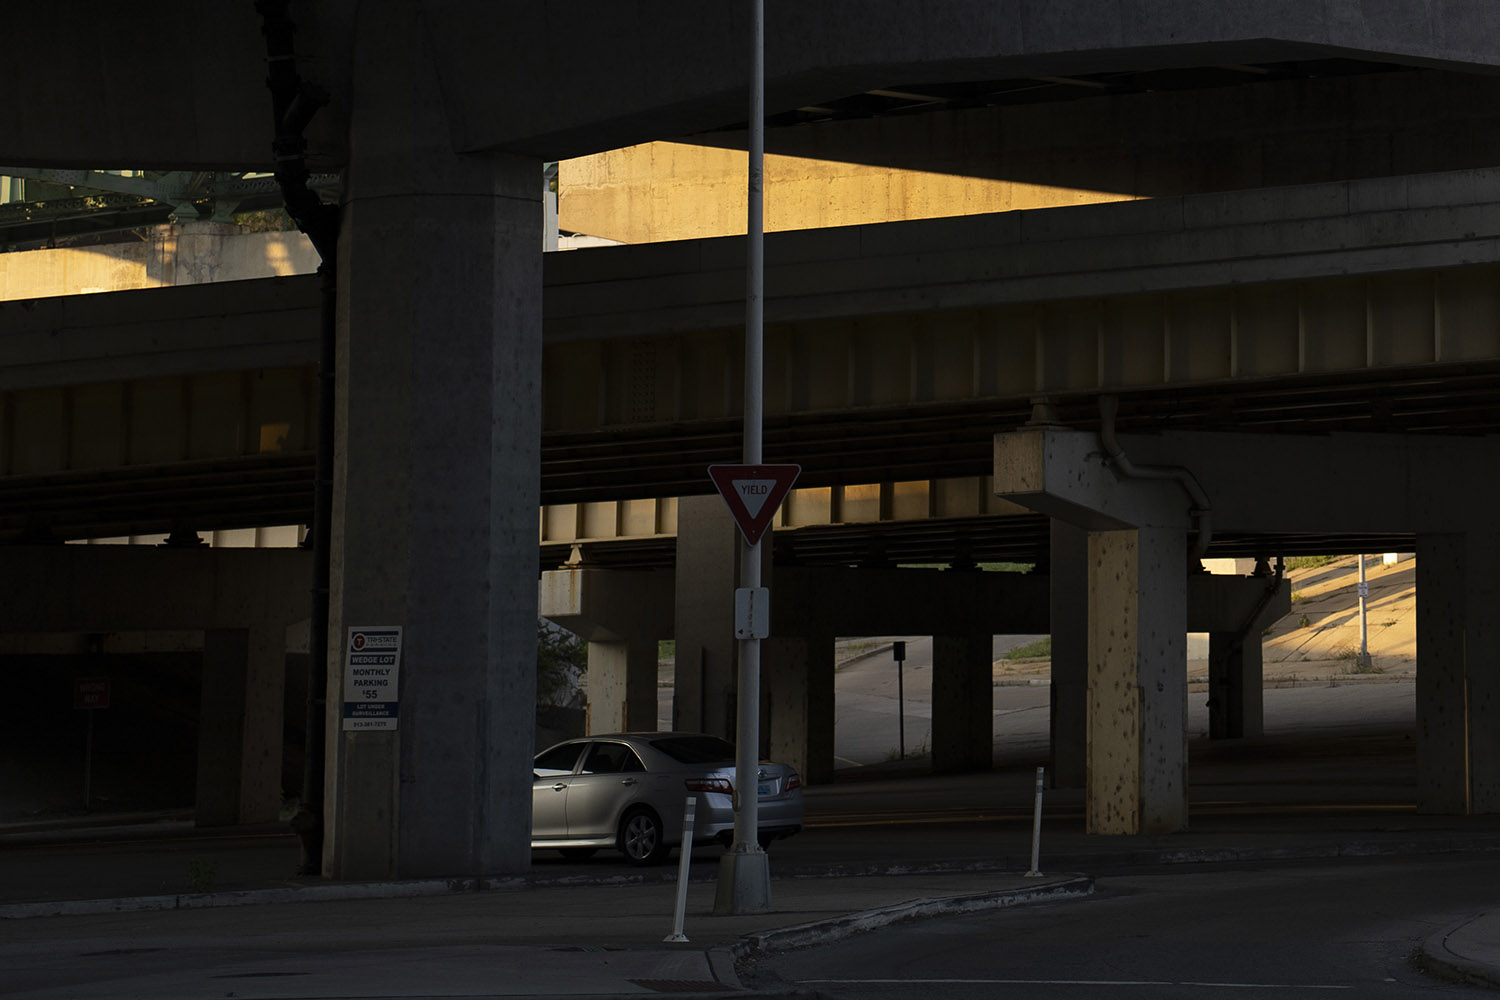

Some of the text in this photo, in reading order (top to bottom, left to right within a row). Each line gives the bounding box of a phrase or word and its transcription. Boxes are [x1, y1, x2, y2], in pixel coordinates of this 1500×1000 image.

[741, 485, 768, 495] YIELD
[351, 655, 394, 664] WEDGE LOT
[352, 668, 390, 676] MONTHLY
[353, 679, 388, 687] PARKING
[362, 690, 377, 699] $55
